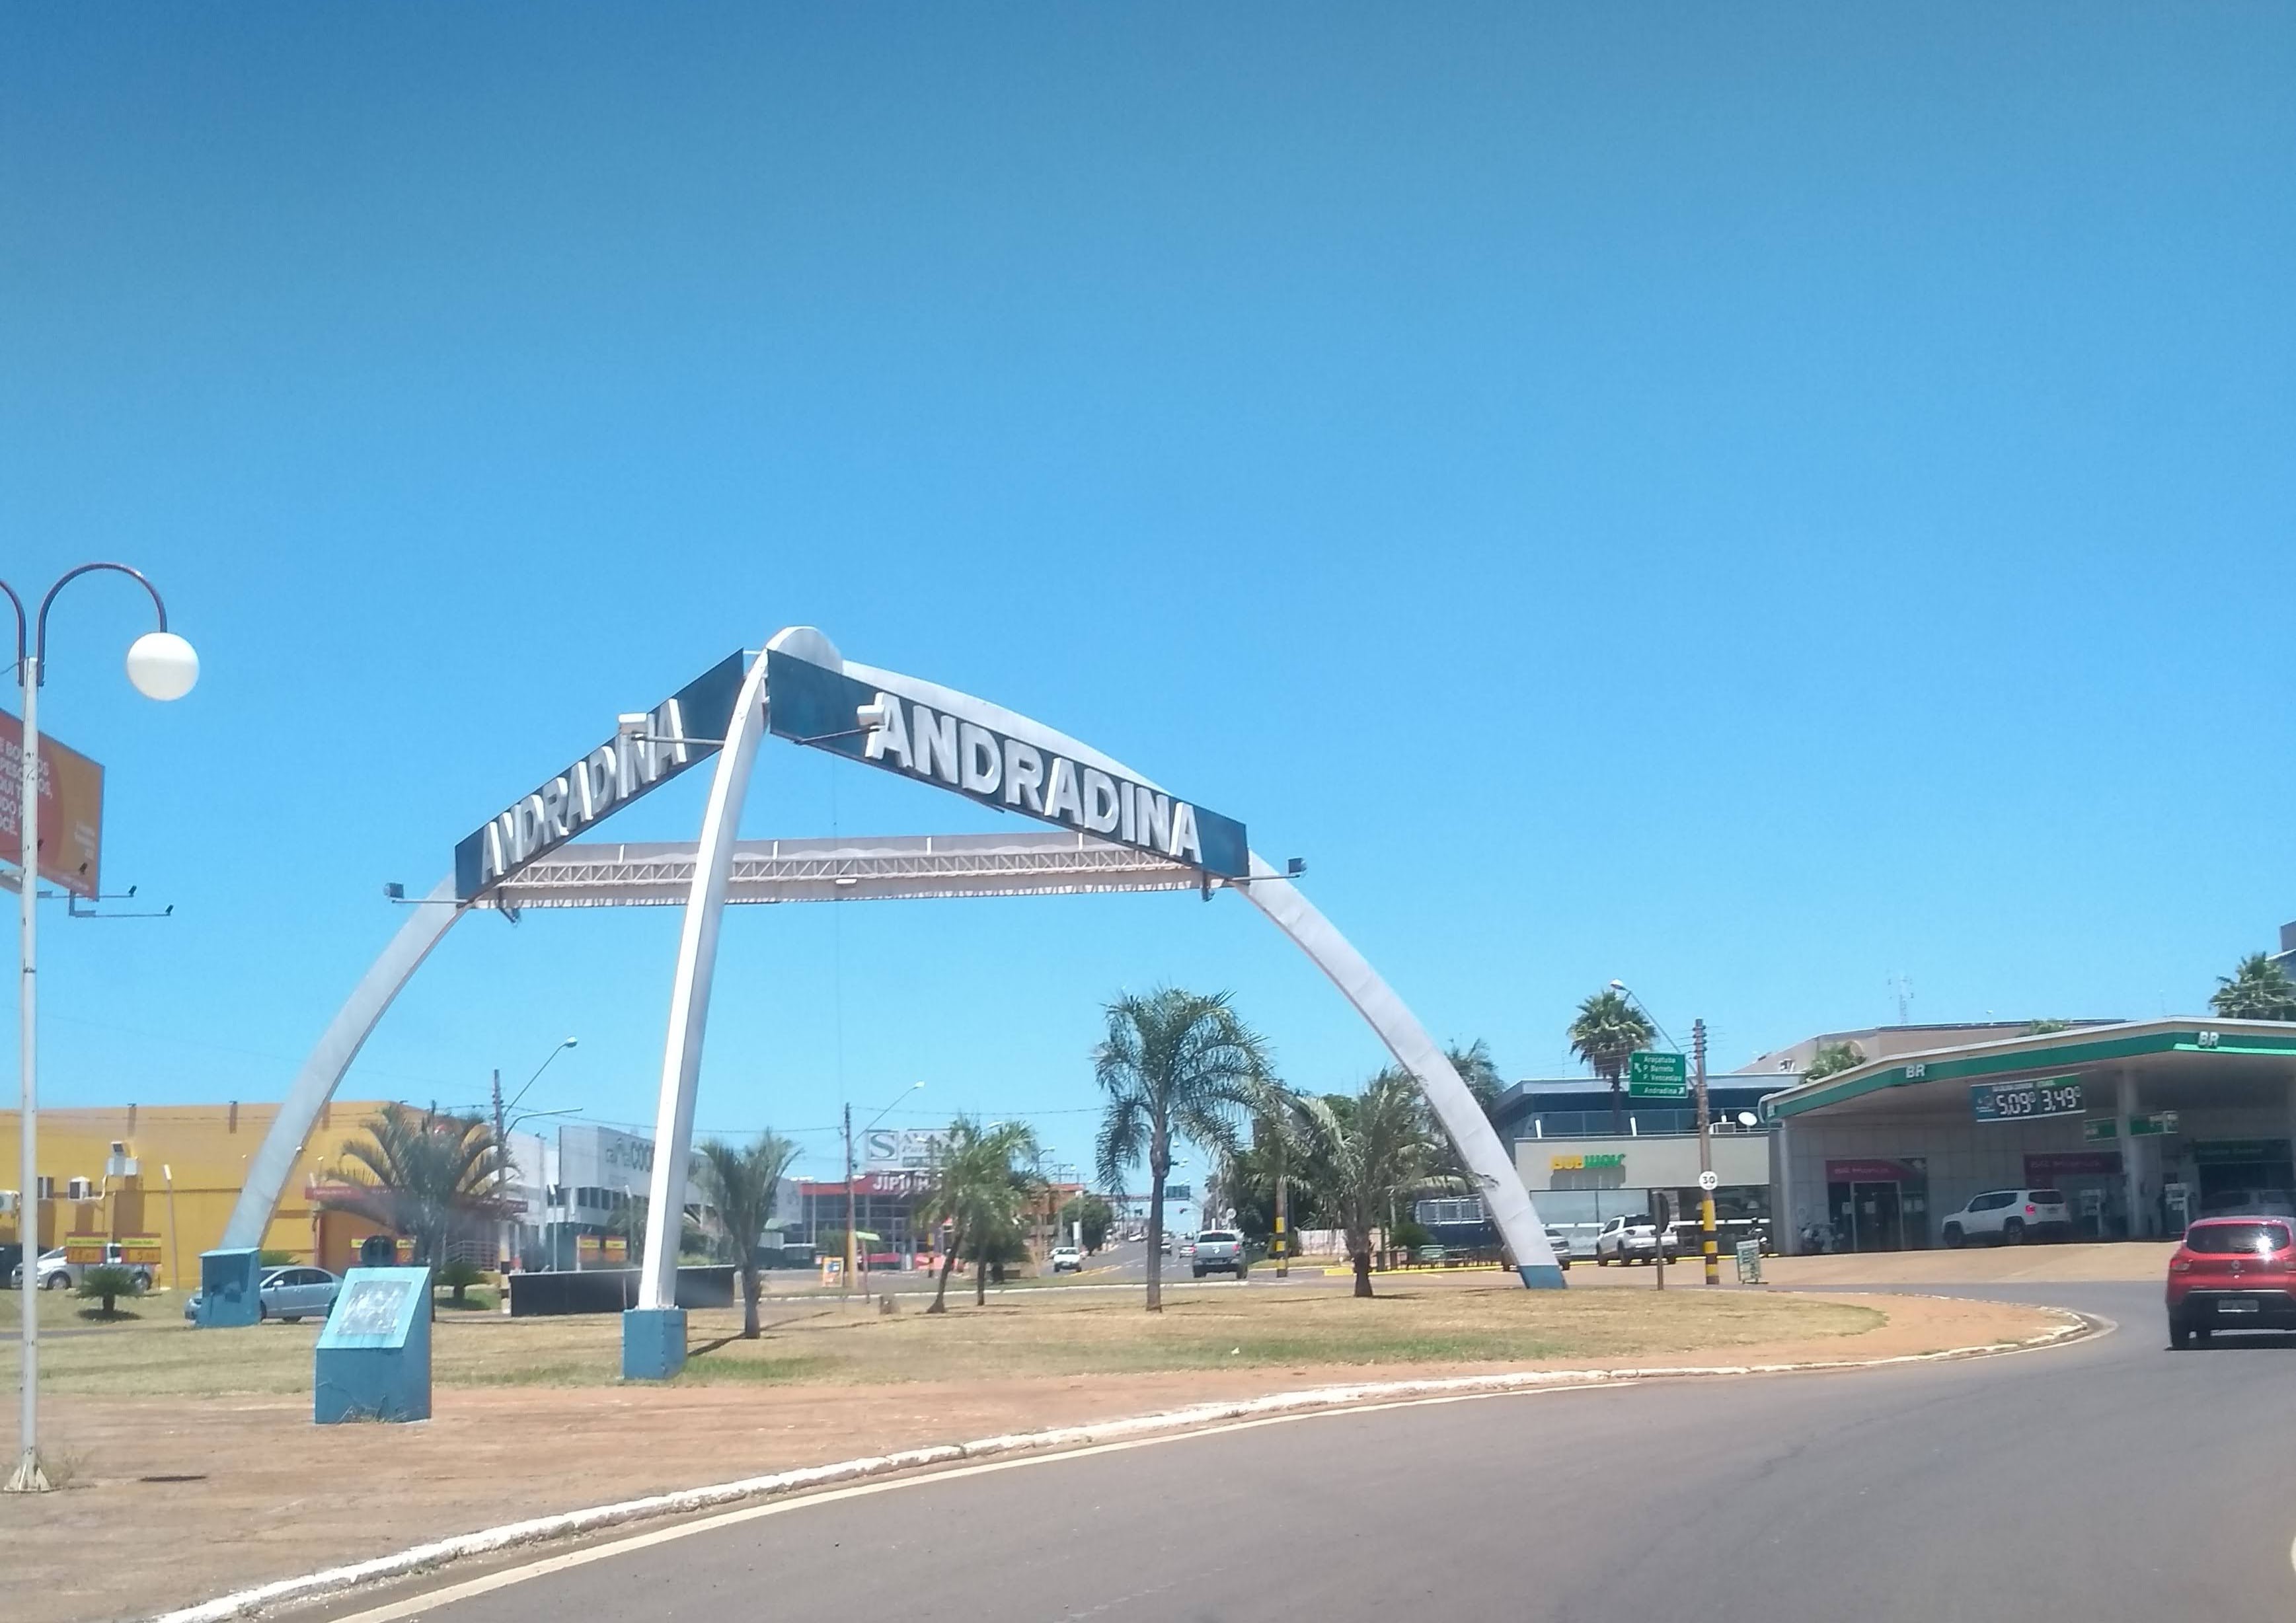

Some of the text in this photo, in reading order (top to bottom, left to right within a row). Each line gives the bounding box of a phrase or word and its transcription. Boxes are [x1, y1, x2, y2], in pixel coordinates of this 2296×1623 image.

[864, 691, 1202, 864] ANDRADINA
[480, 698, 687, 885] ANDRADINA
[2198, 1031, 2219, 1045] BR
[1905, 1064, 1925, 1078] BR
[1552, 1154, 1625, 1170] SUBWAY
[1702, 1176, 1715, 1184] 30
